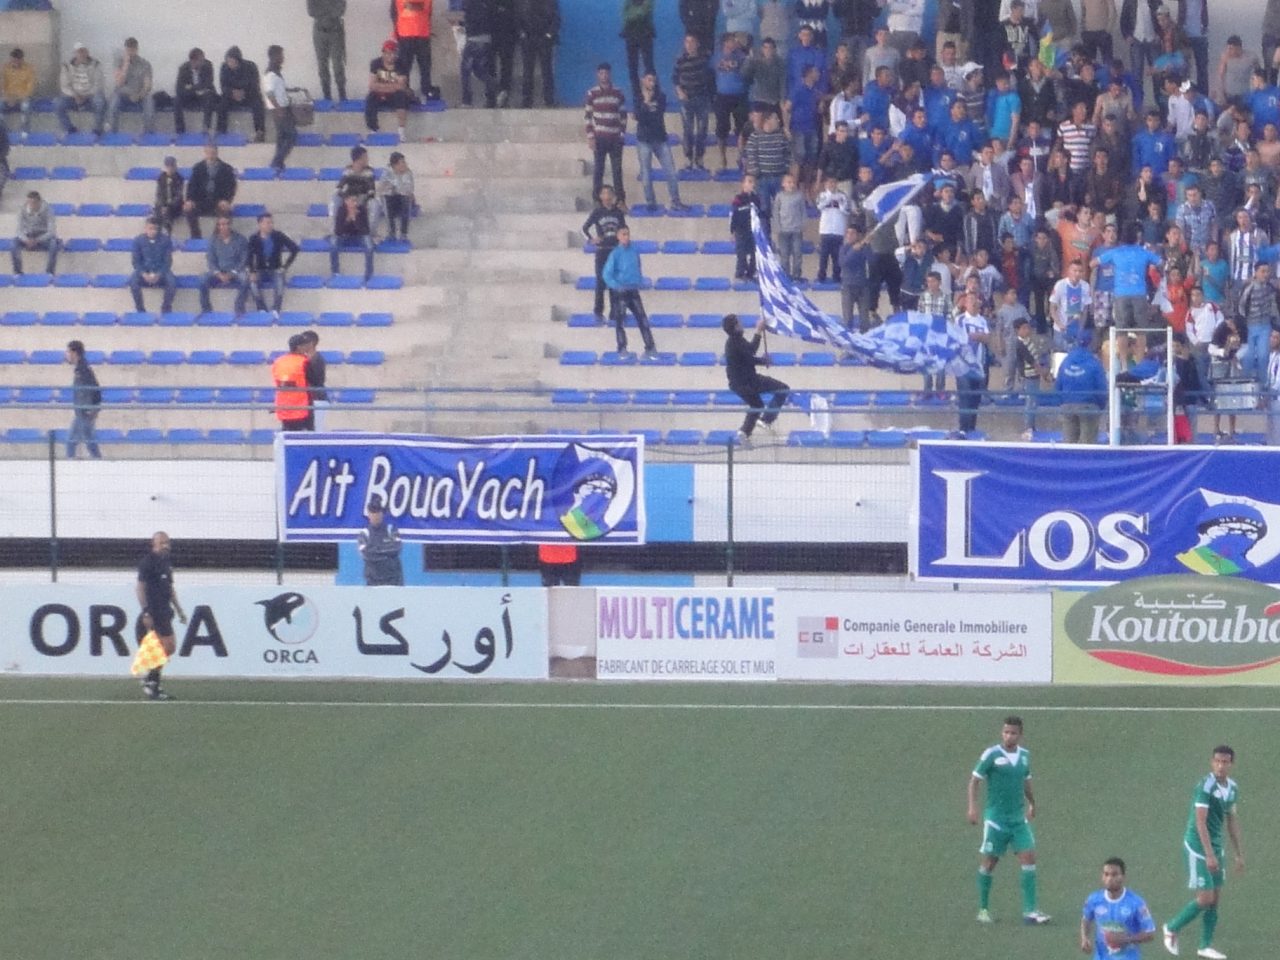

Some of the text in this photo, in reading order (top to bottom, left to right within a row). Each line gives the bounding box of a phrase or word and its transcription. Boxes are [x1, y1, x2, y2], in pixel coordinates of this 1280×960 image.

[289, 455, 546, 522] Ait BouaYach
[930, 470, 1151, 571] Los
[352, 592, 514, 674] أوركا
[599, 596, 776, 640] MULTICERAME
[843, 618, 1028, 635] Companie Generale Immobiliere
[263, 649, 320, 664] ORCA
[599, 659, 776, 674] FABRICANT DE CARRELAGE SOL ET MUR
[843, 639, 1027, 661] الشركة العامة للعقارات
